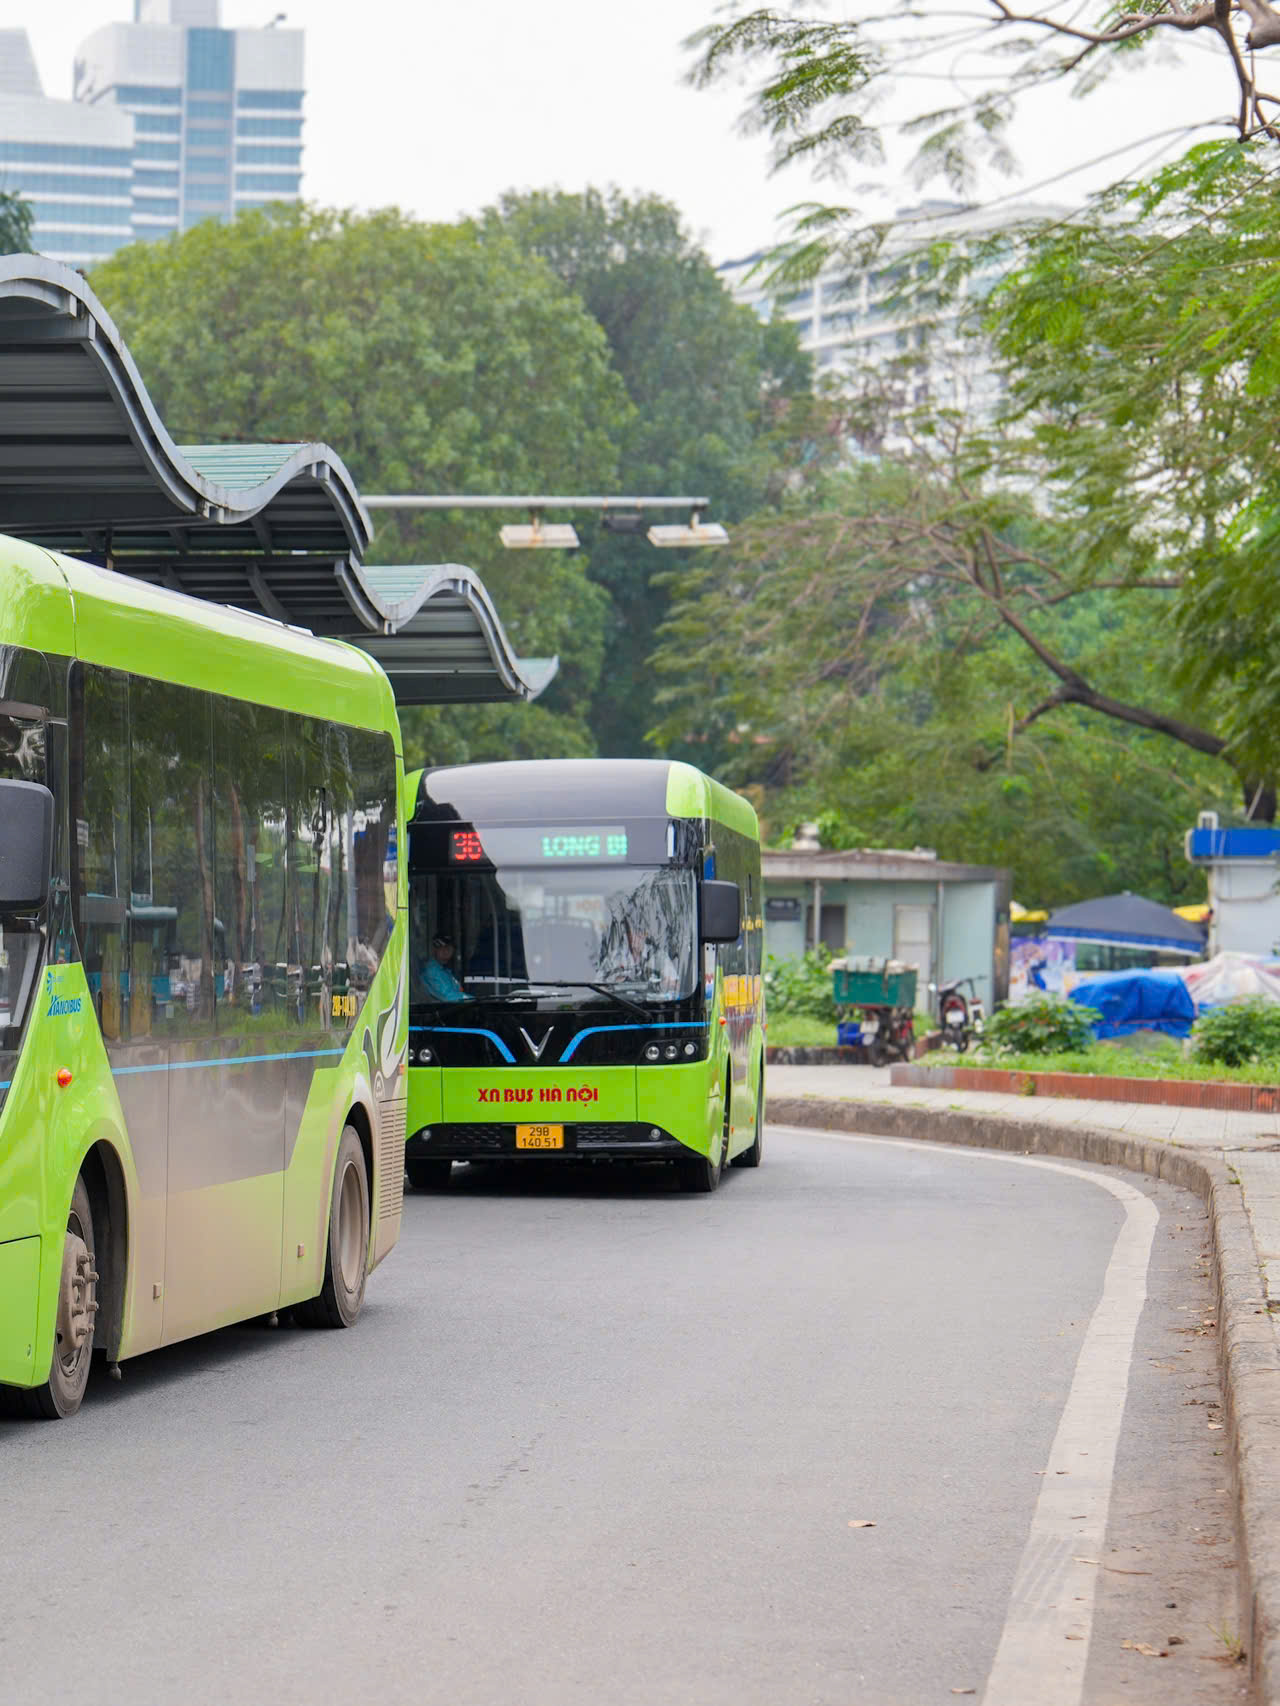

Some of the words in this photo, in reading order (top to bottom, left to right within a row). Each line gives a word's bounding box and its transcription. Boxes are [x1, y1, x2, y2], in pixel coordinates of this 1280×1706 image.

[542, 835, 601, 857] LONG
[503, 1088, 534, 1102] BUS
[539, 1084, 562, 1102] HÀ
[566, 1083, 599, 1107] NỘI
[529, 1127, 549, 1136] 29B
[522, 1137, 557, 1148] 140.51
